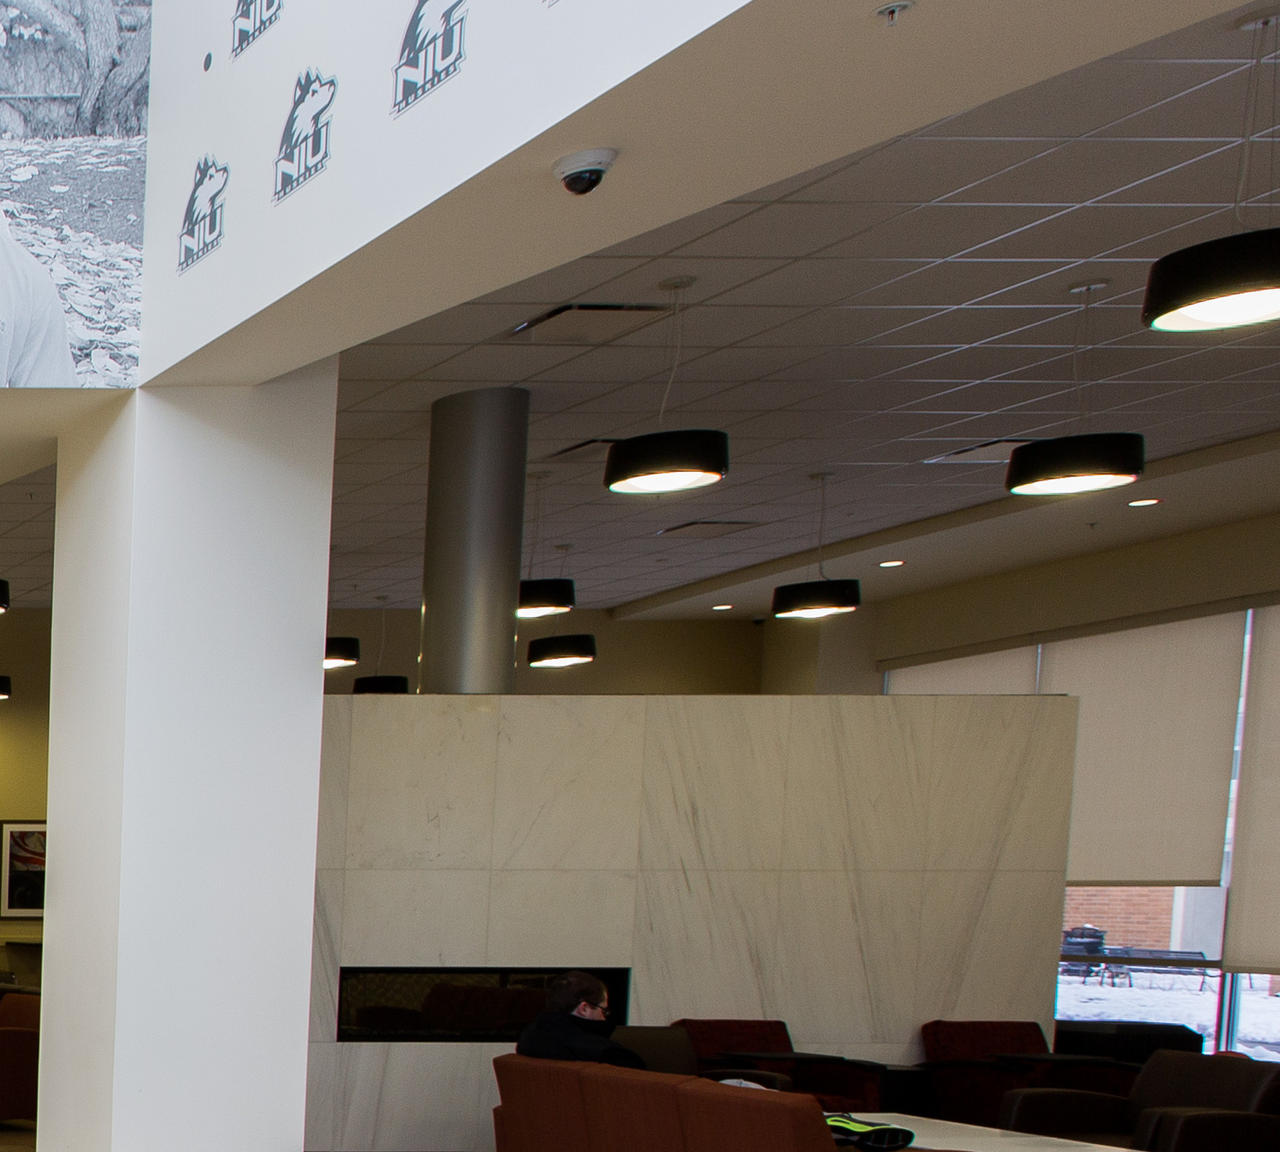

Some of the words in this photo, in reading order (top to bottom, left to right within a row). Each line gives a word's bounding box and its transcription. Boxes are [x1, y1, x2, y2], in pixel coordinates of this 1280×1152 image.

[393, 17, 464, 106] NIU
[274, 120, 329, 196] NIU
[178, 203, 224, 266] NIU
